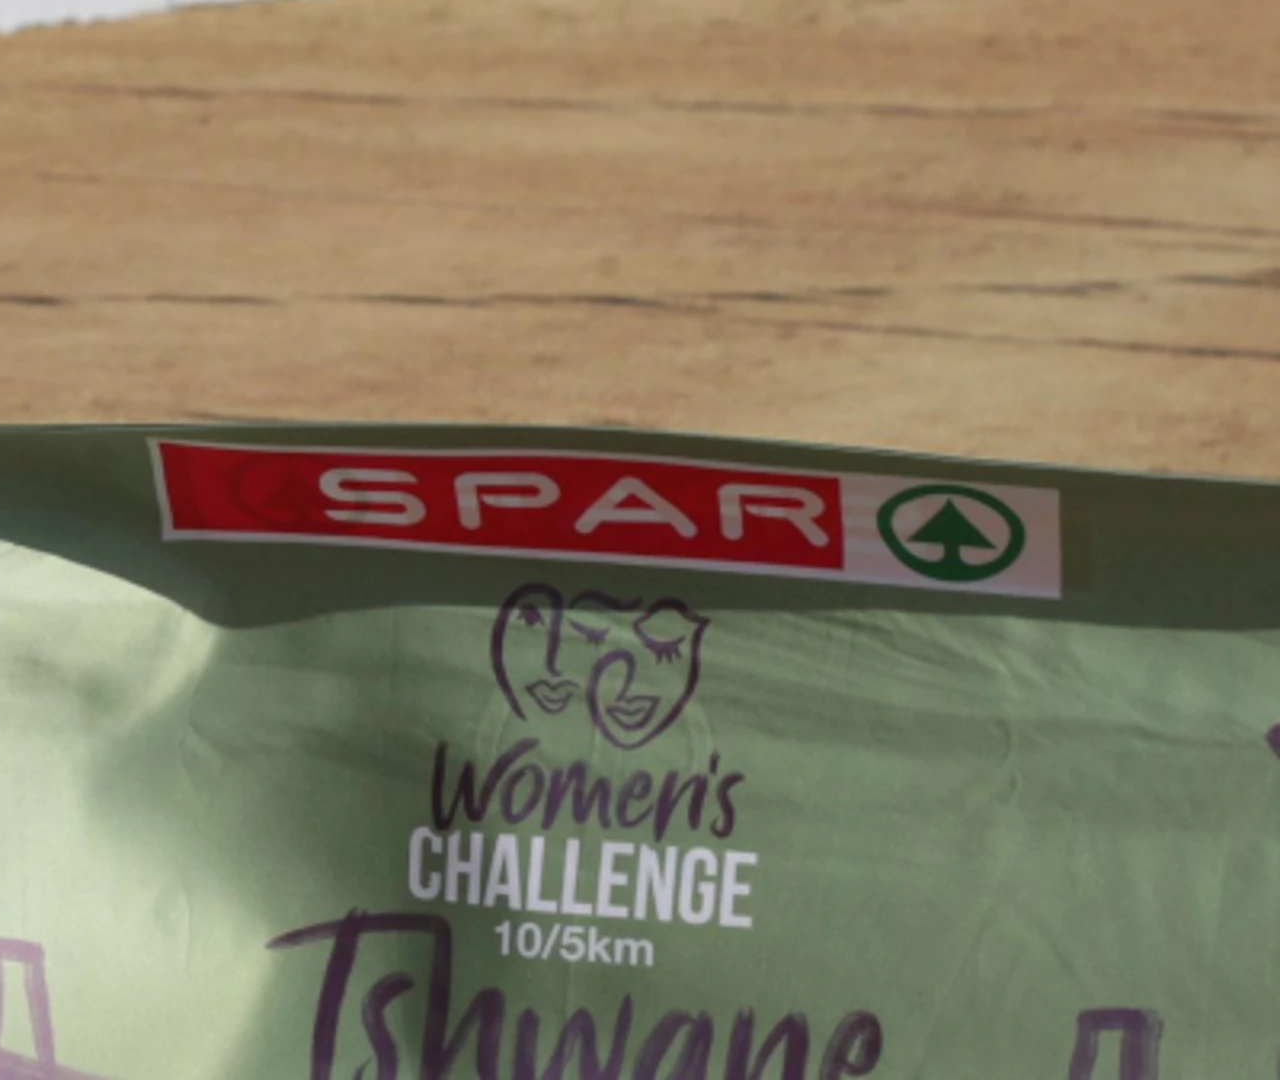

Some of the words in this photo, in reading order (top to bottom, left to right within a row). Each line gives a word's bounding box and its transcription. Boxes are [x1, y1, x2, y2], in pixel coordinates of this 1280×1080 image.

[317, 466, 832, 549] SPAR
[429, 736, 746, 842] Women's
[407, 825, 759, 929] CHALLENGE
[265, 907, 884, 1080] Tshwane
[493, 920, 656, 968] 10/5km
